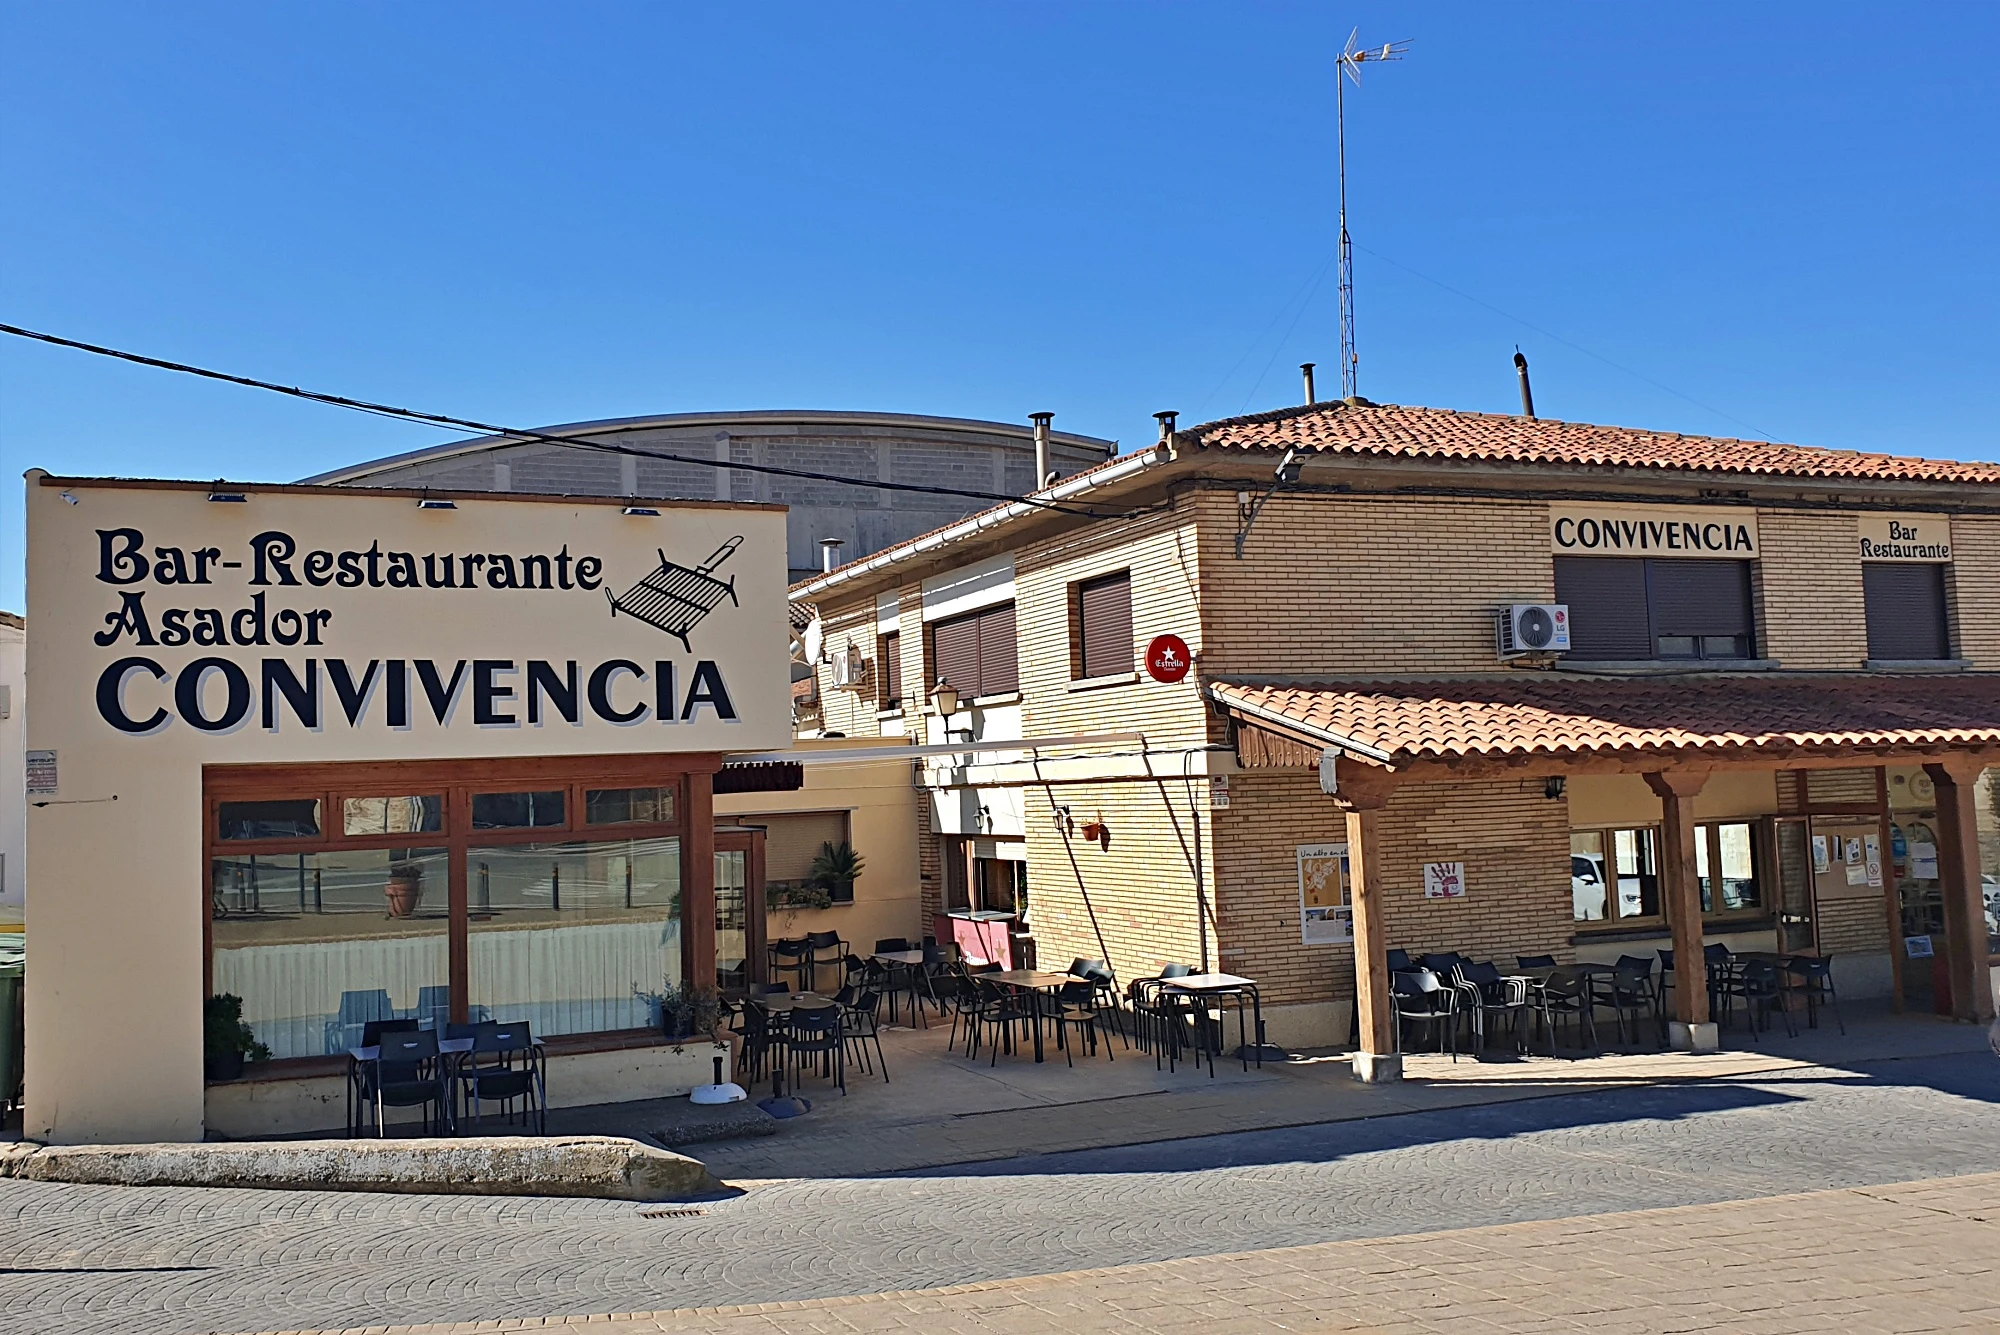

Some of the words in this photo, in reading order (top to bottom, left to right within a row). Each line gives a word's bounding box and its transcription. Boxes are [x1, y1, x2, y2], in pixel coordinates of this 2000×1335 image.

[1554, 517, 1753, 552] CONVIVENCIA
[1888, 520, 1918, 541] Bar
[94, 527, 604, 590] Bar-Restaurante
[1859, 537, 1950, 559] Restaurante
[93, 590, 333, 647] Asador
[1556, 624, 1566, 632] LG
[1155, 659, 1184, 668] Estrella
[95, 656, 740, 736] CONVIVENCIA
[1313, 849, 1328, 857] alto
